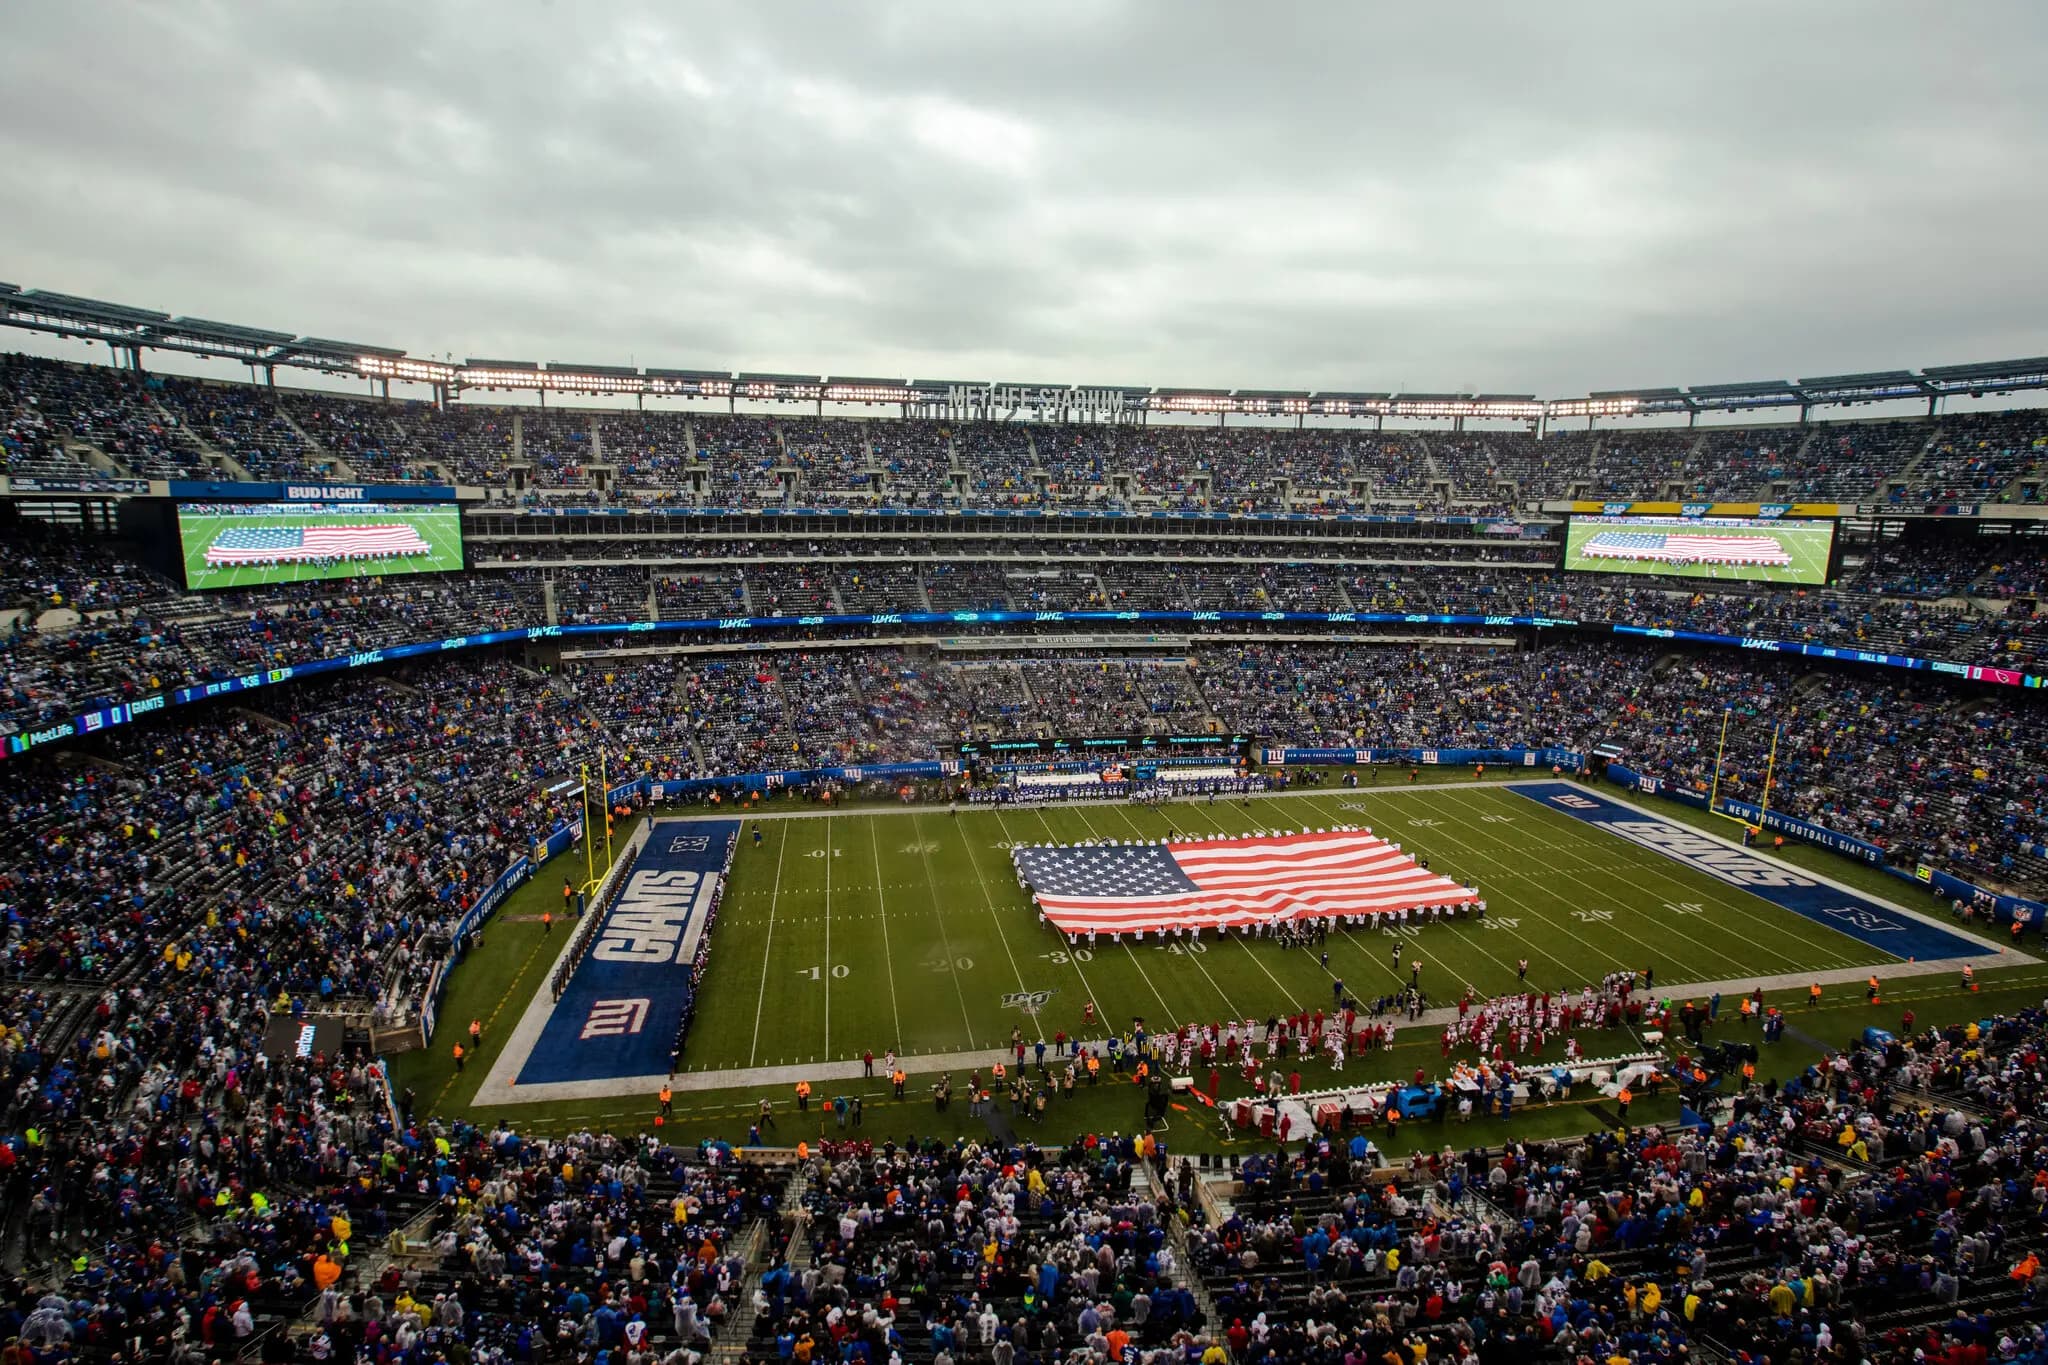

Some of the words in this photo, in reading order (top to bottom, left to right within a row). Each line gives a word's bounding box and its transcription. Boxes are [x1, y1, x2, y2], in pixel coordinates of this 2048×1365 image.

[949, 385, 1031, 411] METLIFE
[1039, 388, 1124, 413] STADIUM
[287, 486, 321, 499] BUD
[322, 486, 364, 499] LIGHT
[1603, 505, 1625, 515] SAP
[1682, 506, 1703, 517] SAP
[1759, 507, 1784, 518] SAP
[1858, 652, 1875, 662] BALL
[1931, 661, 1967, 675] CARDINALS
[132, 695, 165, 714] GIANTS
[111, 707, 122, 724] 0
[29, 723, 74, 746] MetLife
[1728, 804, 1751, 818] NEW
[1755, 812, 1780, 828] YORK
[1784, 821, 1834, 846] FOOTBALL
[1609, 821, 1818, 887] GIANTS
[1918, 867, 1931, 879] 25
[592, 869, 701, 964] GIANTS
[1050, 949, 1093, 964] 30
[807, 965, 850, 981] 10
